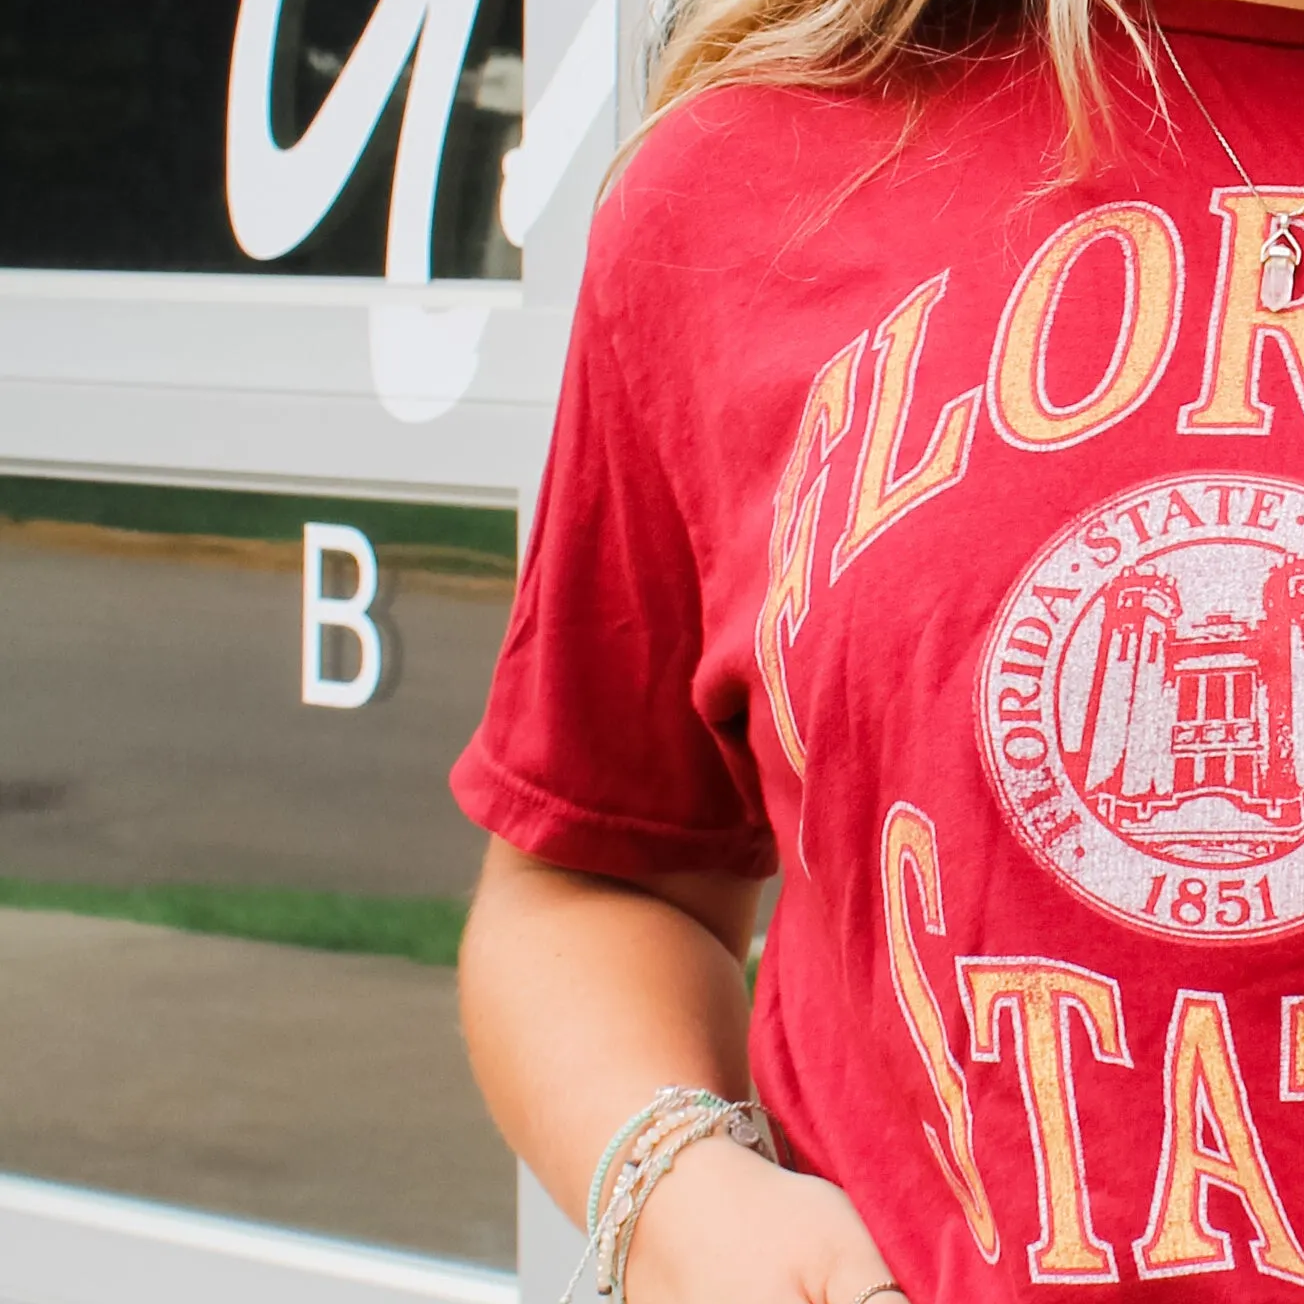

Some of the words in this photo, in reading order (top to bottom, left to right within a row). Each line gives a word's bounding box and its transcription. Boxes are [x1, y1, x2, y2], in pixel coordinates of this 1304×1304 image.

[1000, 582, 1082, 848] FLORIDA
[1083, 484, 1287, 568] STATE
[1140, 873, 1278, 928] 1851
